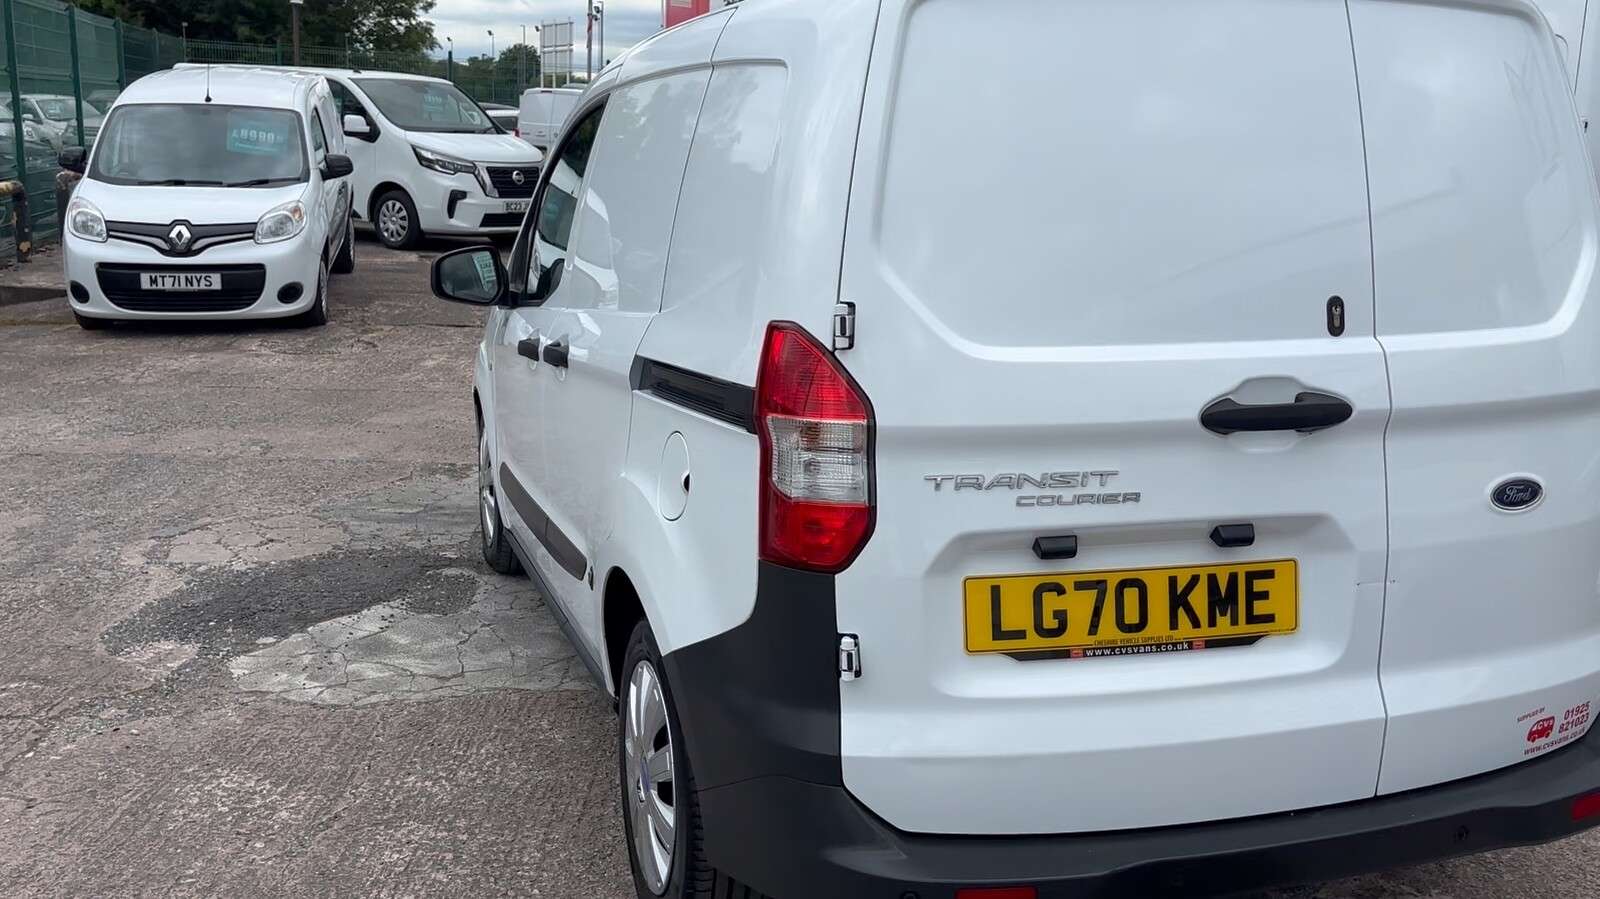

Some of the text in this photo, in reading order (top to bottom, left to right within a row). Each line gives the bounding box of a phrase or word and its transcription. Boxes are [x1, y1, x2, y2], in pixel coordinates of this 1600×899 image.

[149, 275, 213, 287] MT71 NYS
[924, 470, 1119, 491] TRANSIT
[1016, 492, 1141, 507] COURIER
[1503, 485, 1532, 502] Ford
[990, 569, 1276, 641] LG70 KME
[1085, 641, 1190, 657] www.cvsvans.co.uk
[1120, 637, 1140, 645] VEHICLE
[1564, 701, 1591, 721] 01925
[1558, 713, 1590, 734] 821023
